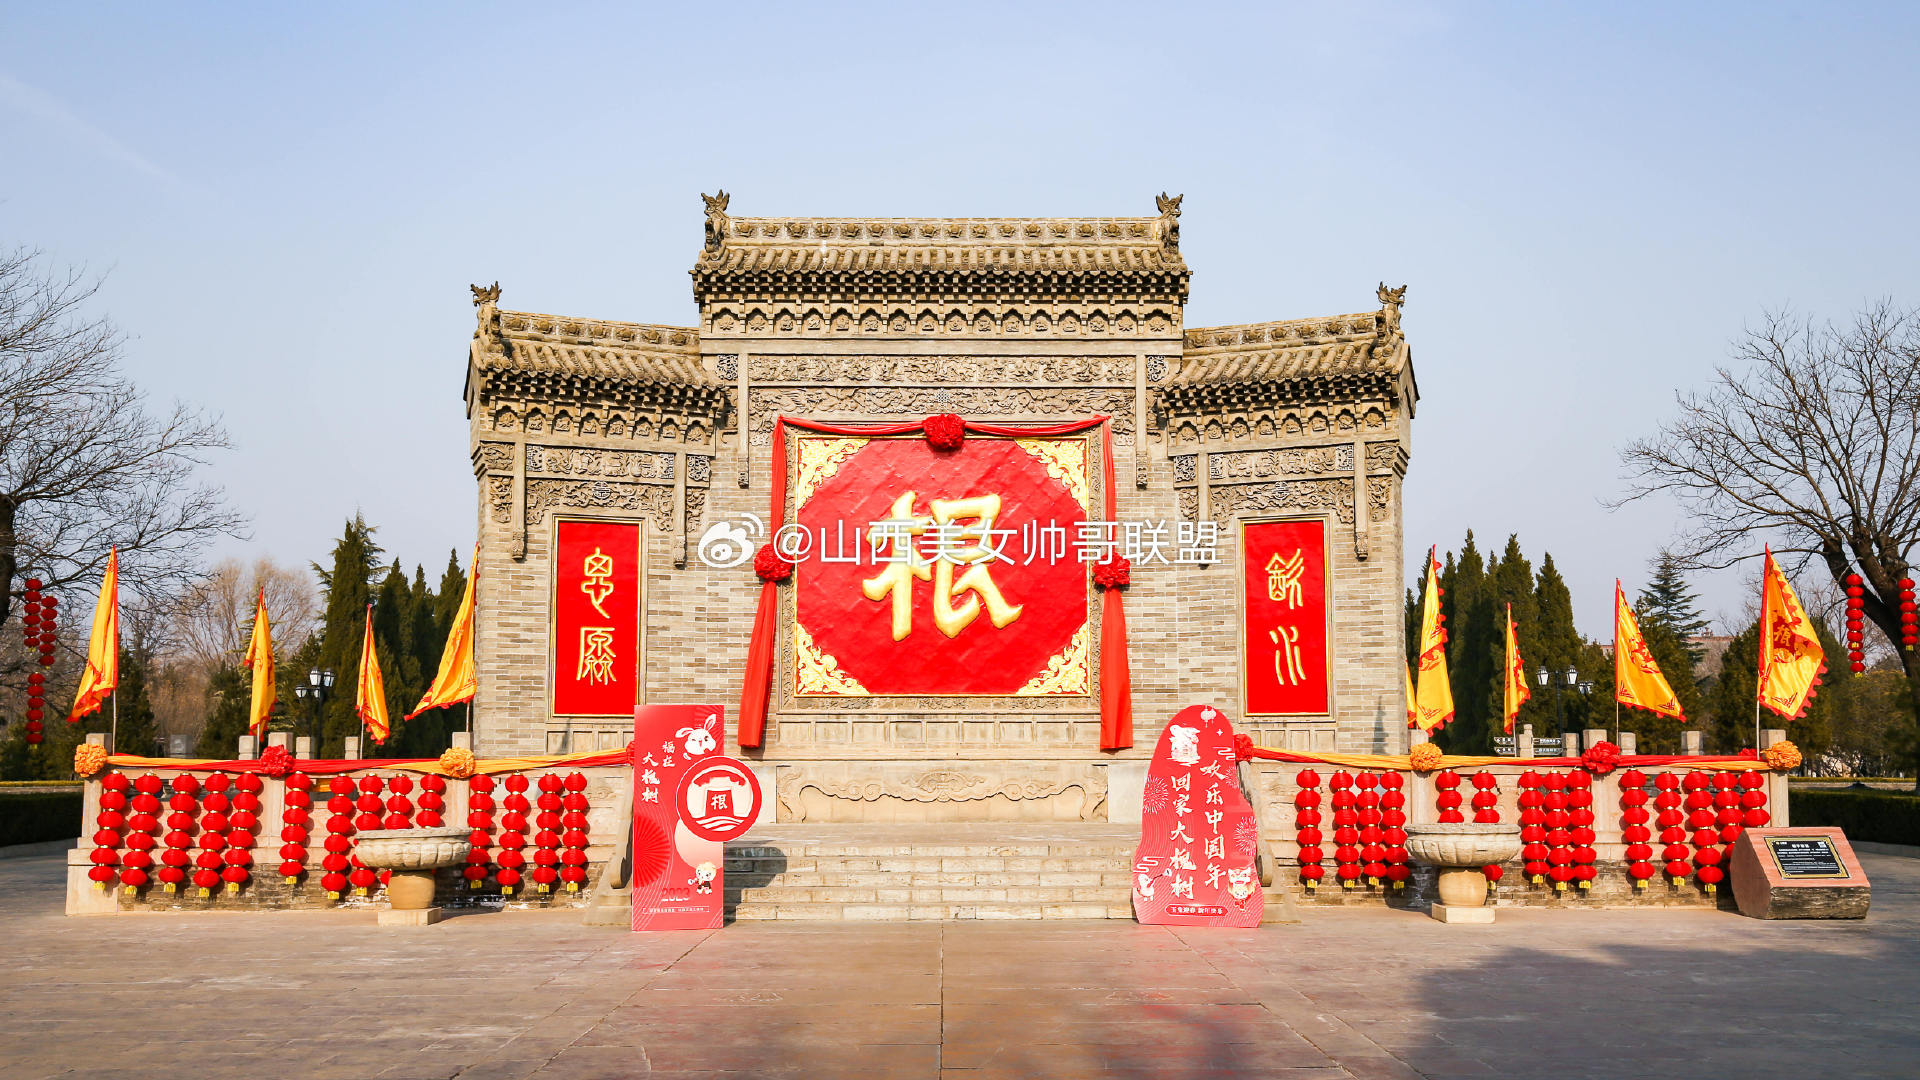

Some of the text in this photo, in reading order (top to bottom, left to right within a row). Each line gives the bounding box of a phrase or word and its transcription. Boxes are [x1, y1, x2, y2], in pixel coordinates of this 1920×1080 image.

[862, 490, 1025, 642] 根
[641, 751, 661, 804] 大槐树
[662, 740, 676, 768] 福在
[710, 793, 728, 811] 根
[1169, 772, 1197, 900] 回家大槐树
[1200, 759, 1227, 890] 欢乐中国年
